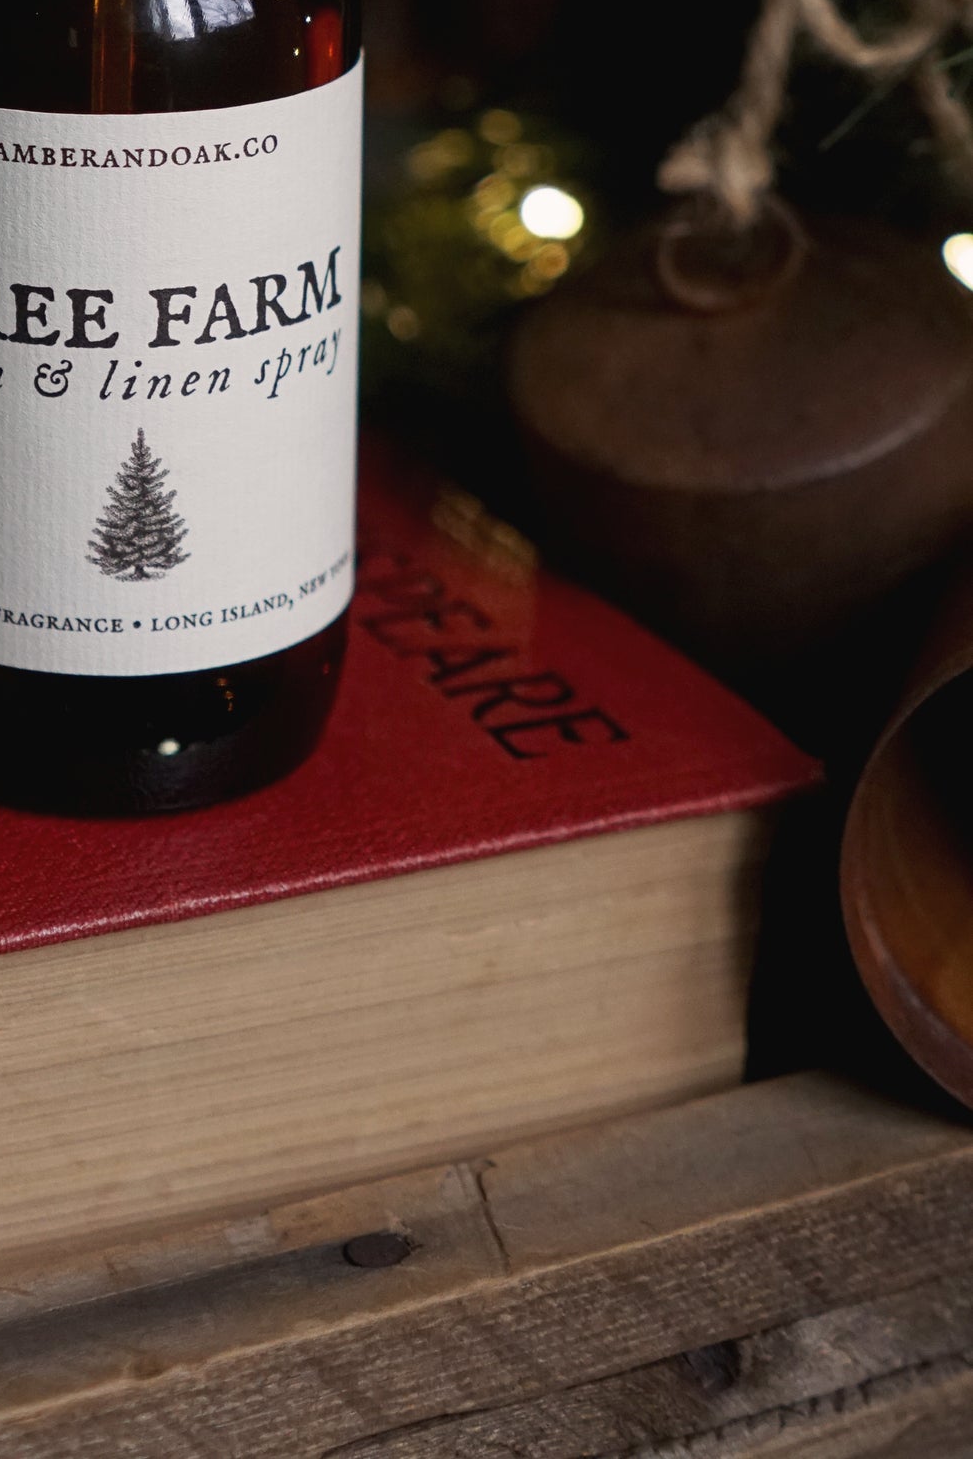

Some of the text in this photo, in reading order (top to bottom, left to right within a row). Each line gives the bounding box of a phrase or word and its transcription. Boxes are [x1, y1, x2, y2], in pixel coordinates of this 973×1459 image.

[147, 245, 343, 349] FARM
[33, 359, 74, 398] &
[99, 359, 232, 401] linen
[253, 325, 344, 400] spray
[150, 611, 214, 633] LONG
[220, 592, 294, 623] ISLAND,
[299, 570, 328, 598] NEW
